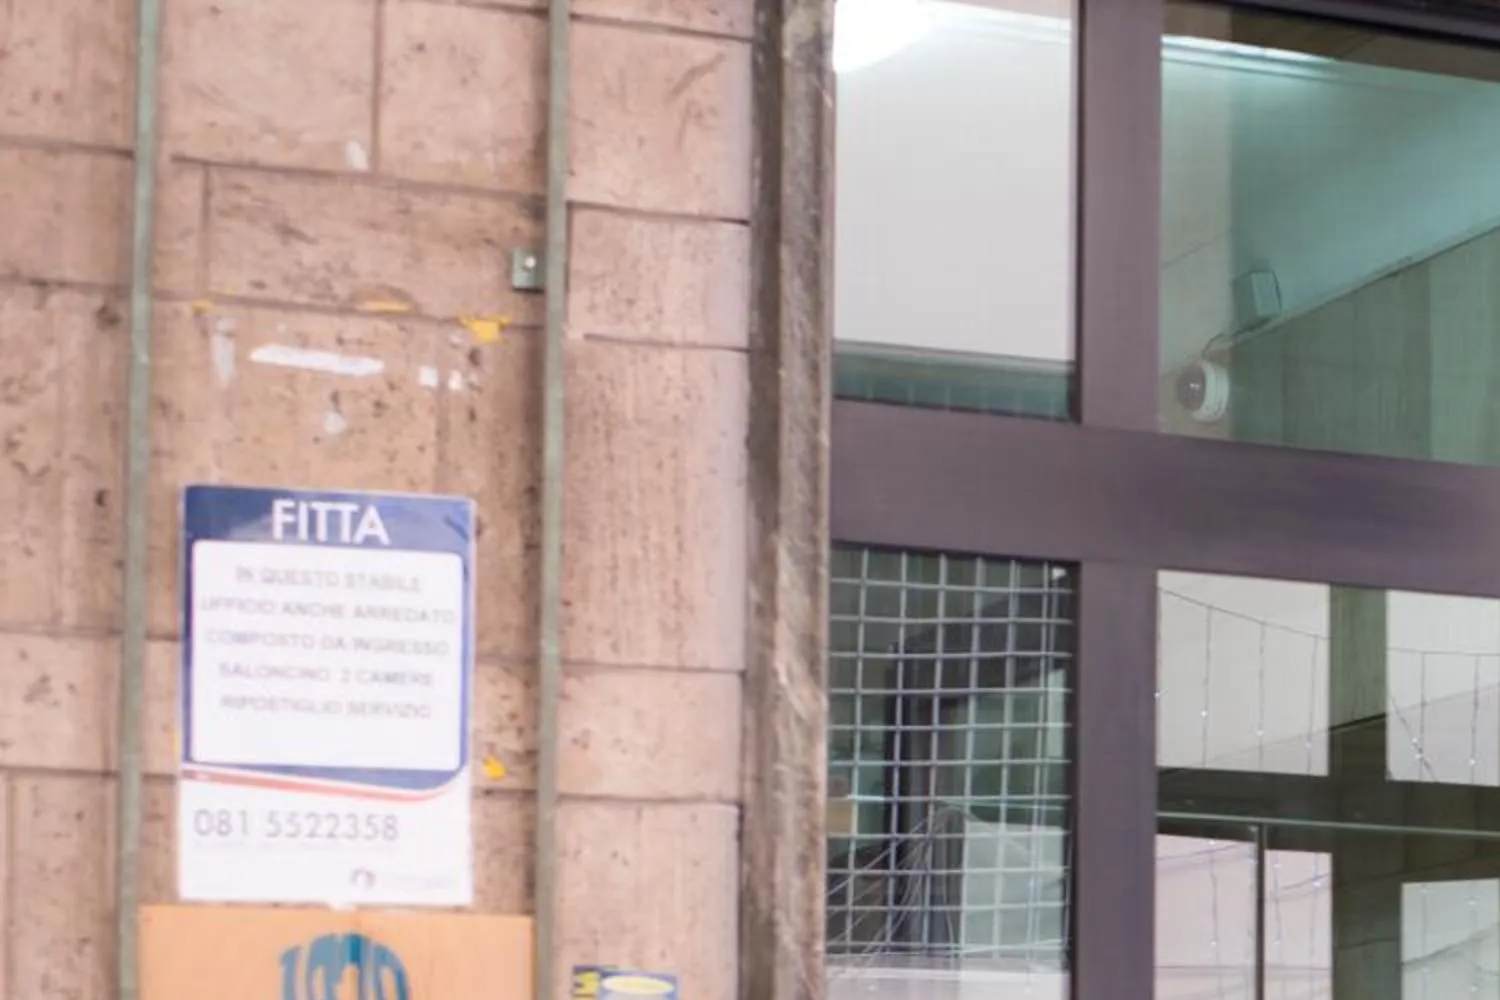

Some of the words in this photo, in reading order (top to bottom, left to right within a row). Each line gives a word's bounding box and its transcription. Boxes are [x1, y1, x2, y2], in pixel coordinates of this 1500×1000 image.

[272, 499, 390, 545] FITTA
[259, 568, 340, 587] QUESTO
[200, 596, 275, 615] UFFICIO
[282, 602, 344, 618] ANCHE
[353, 605, 454, 623] ARREDATO
[205, 629, 315, 650] COMPOSTO
[320, 635, 344, 650] DA
[352, 637, 449, 656] INGRESSO
[194, 808, 248, 838] 081
[265, 809, 399, 841] 5522358
